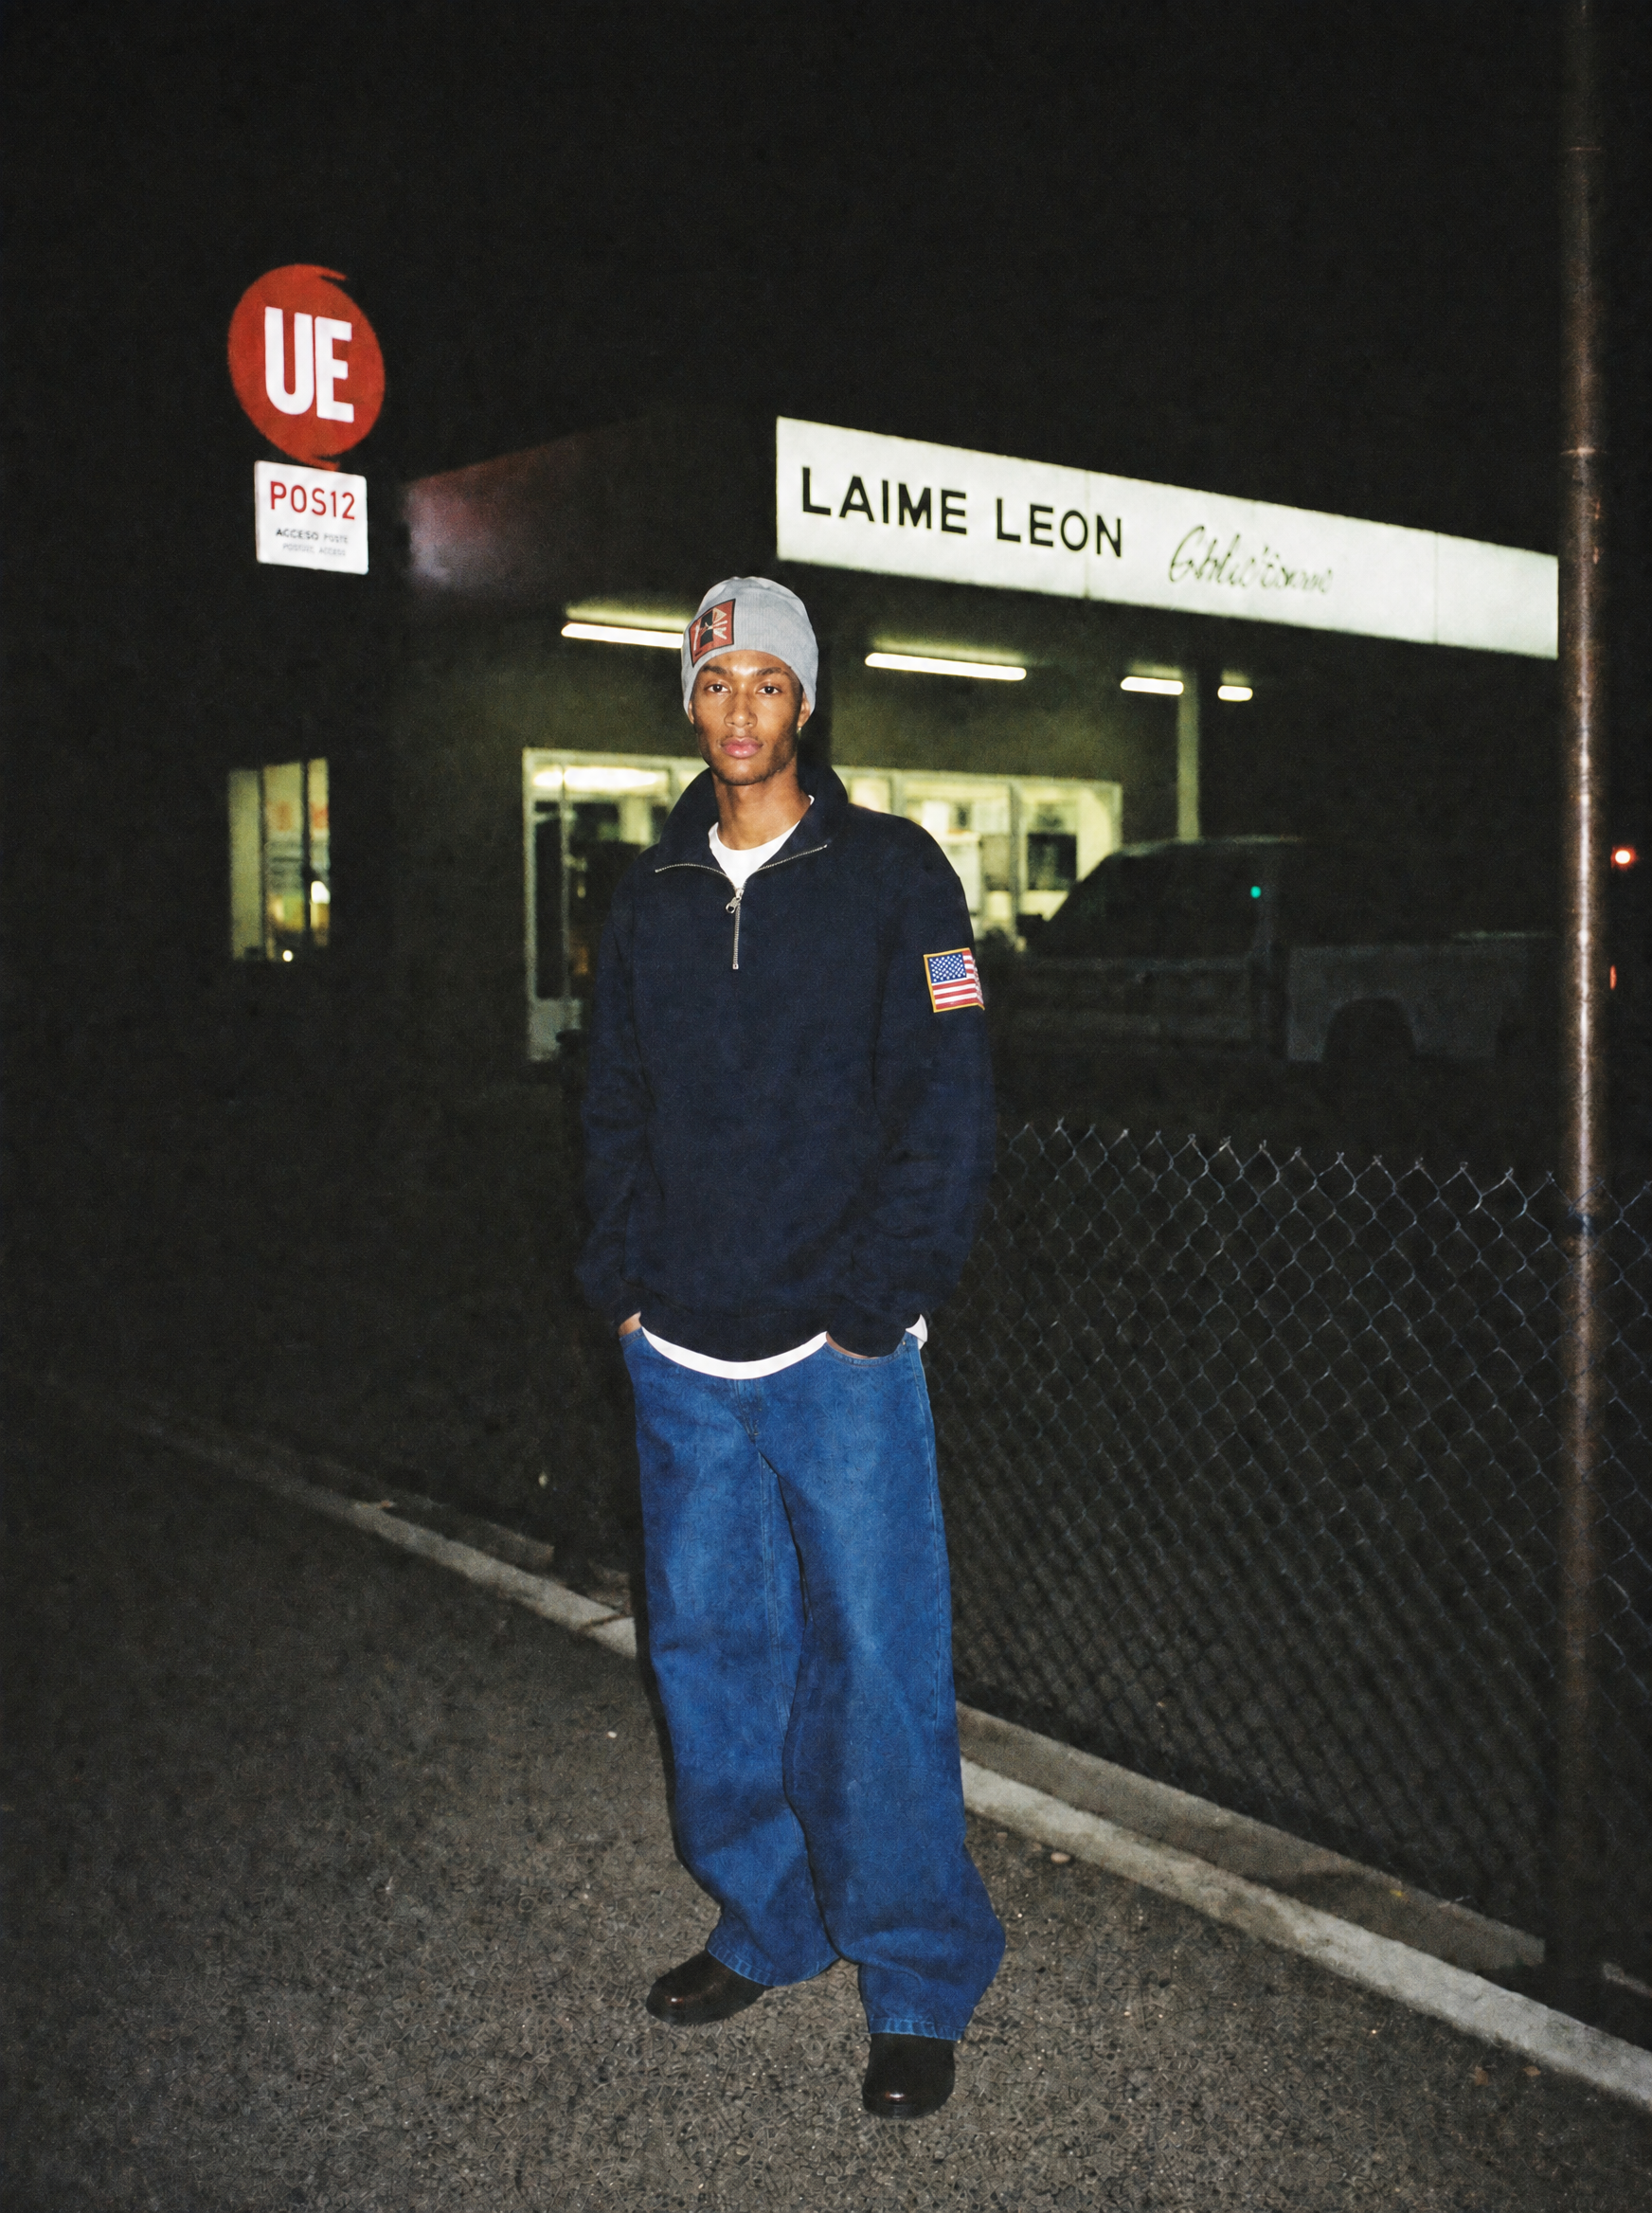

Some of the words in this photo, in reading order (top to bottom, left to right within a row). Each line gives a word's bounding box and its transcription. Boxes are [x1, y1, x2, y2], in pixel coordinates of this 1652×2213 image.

[264, 306, 355, 423] UE
[270, 480, 355, 521] POS12
[802, 466, 967, 535] LAIME
[996, 497, 1122, 557] LEON
[276, 528, 319, 541] ACCESO
